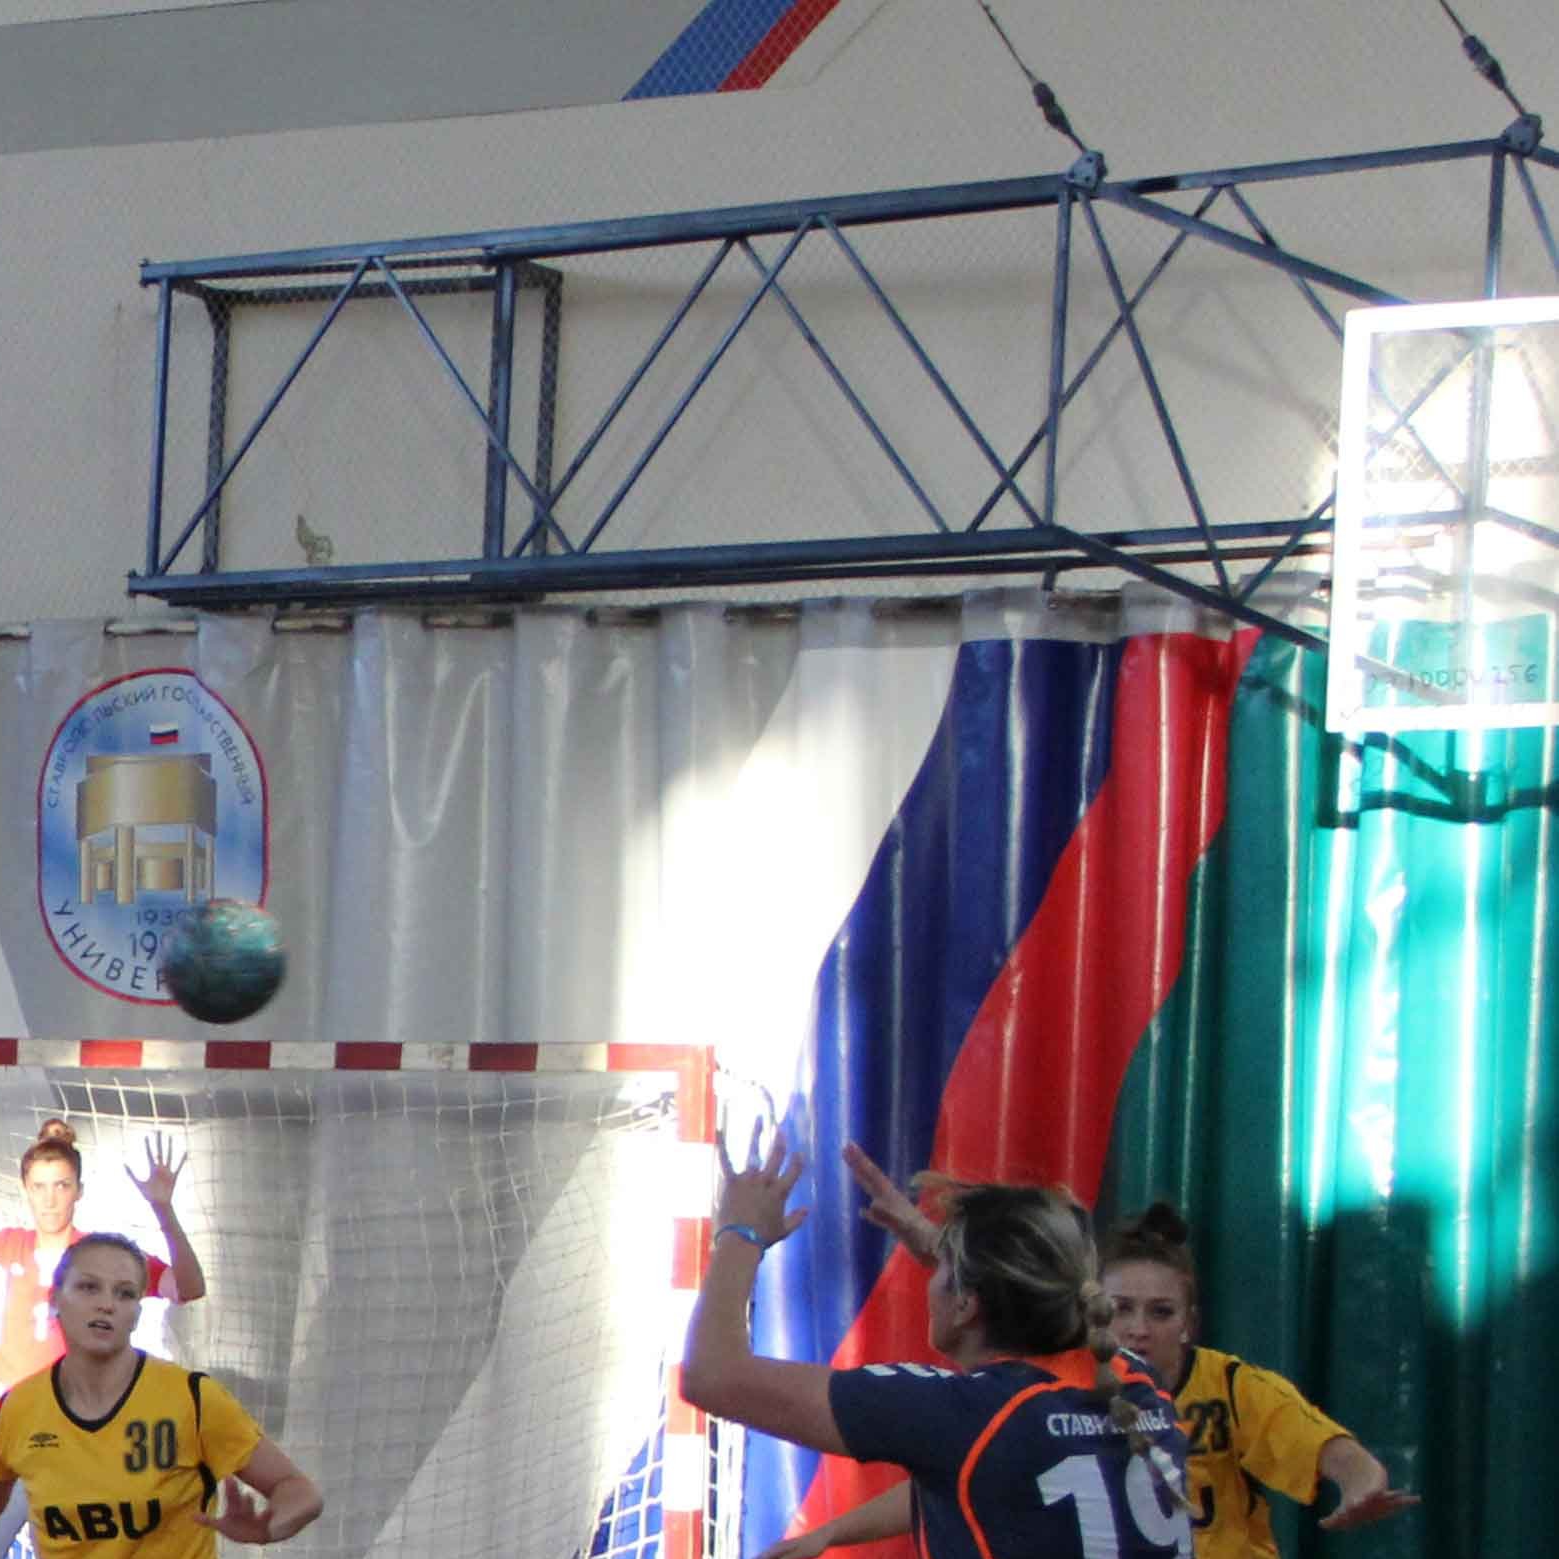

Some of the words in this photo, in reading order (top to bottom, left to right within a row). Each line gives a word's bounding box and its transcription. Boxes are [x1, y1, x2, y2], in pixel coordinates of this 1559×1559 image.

[53, 899, 169, 992] УНИВЕР
[125, 1418, 178, 1473] 30
[1046, 1409, 1171, 1437] СТАВЛЬЕ
[44, 1498, 161, 1541] ABU
